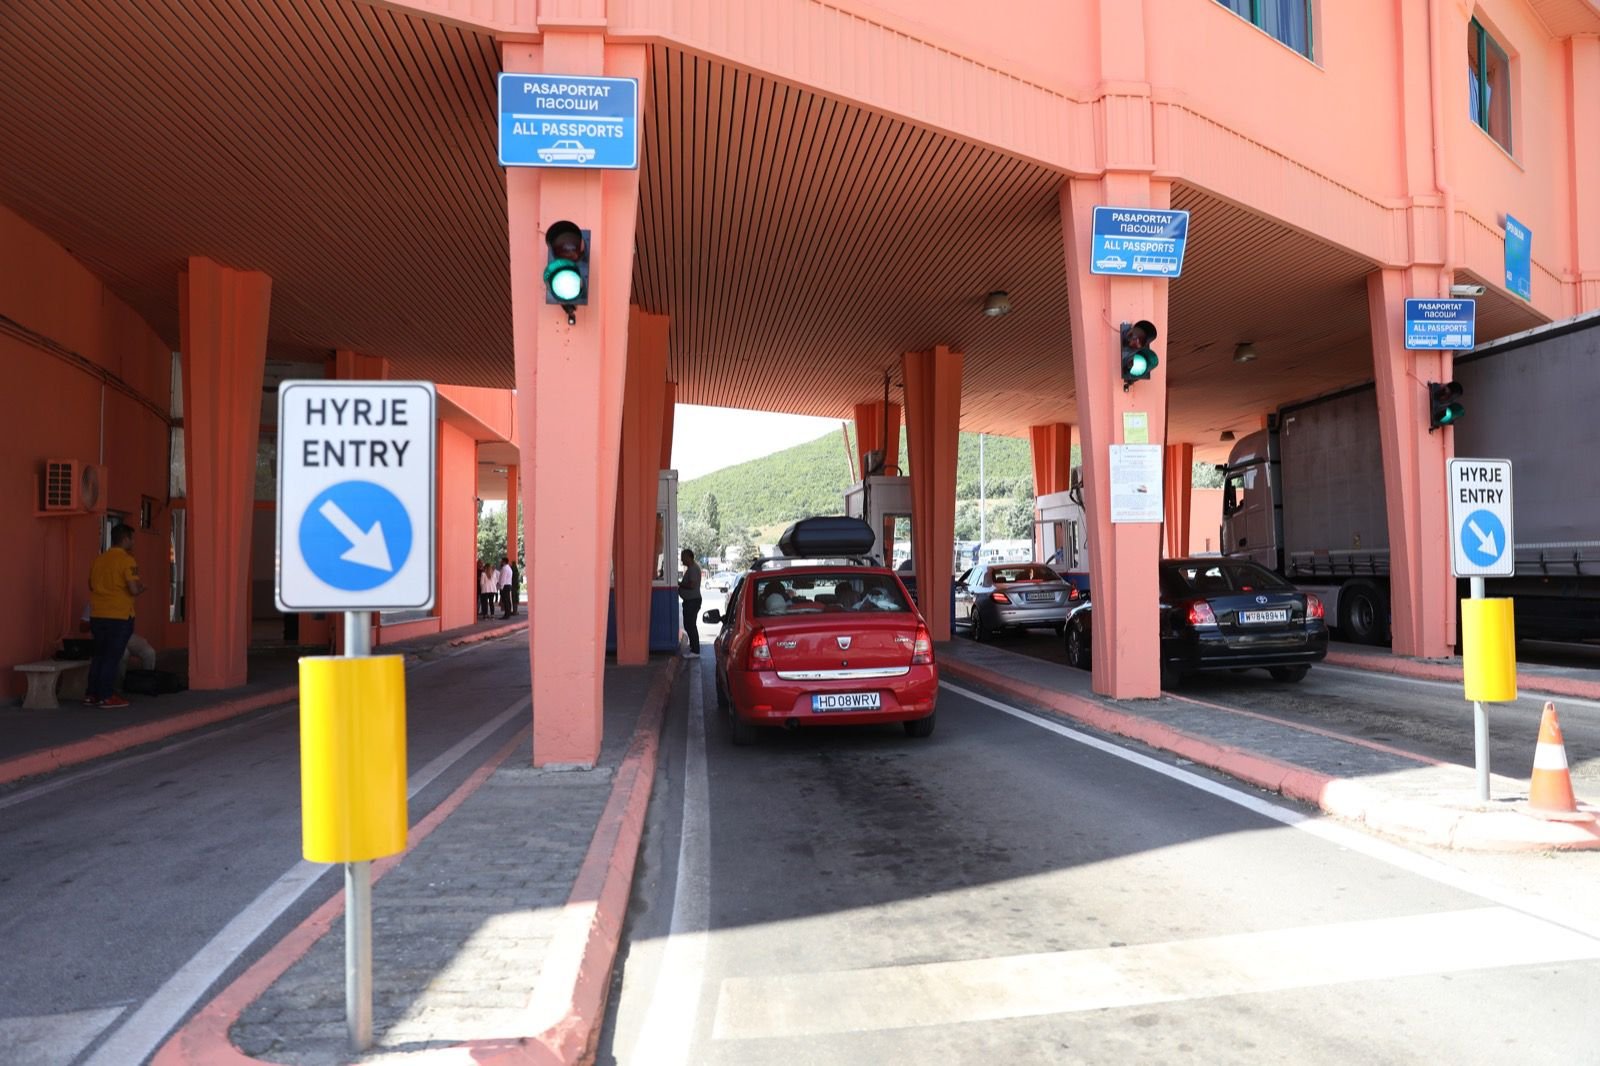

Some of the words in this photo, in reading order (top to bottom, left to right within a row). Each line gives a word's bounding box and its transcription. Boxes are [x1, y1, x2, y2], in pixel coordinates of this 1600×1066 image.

[523, 83, 610, 97] PASAPORTAT
[536, 97, 599, 111] пасоши
[512, 122, 538, 135] ALL
[542, 123, 624, 138] PASSPORTS
[1112, 213, 1172, 224] PASAPORTAT
[1120, 224, 1164, 234] пасоши
[1104, 240, 1121, 250] ALL
[1123, 241, 1175, 253] PASSPORTS
[1418, 303, 1462, 311] PASAPORTAT
[1413, 324, 1426, 332] ALL
[1427, 324, 1468, 332] PASSPORTS
[306, 398, 408, 426] HYRJE
[302, 440, 411, 467] ENTRY
[1460, 466, 1503, 482] HYRJE
[1460, 488, 1504, 504] ENTRY
